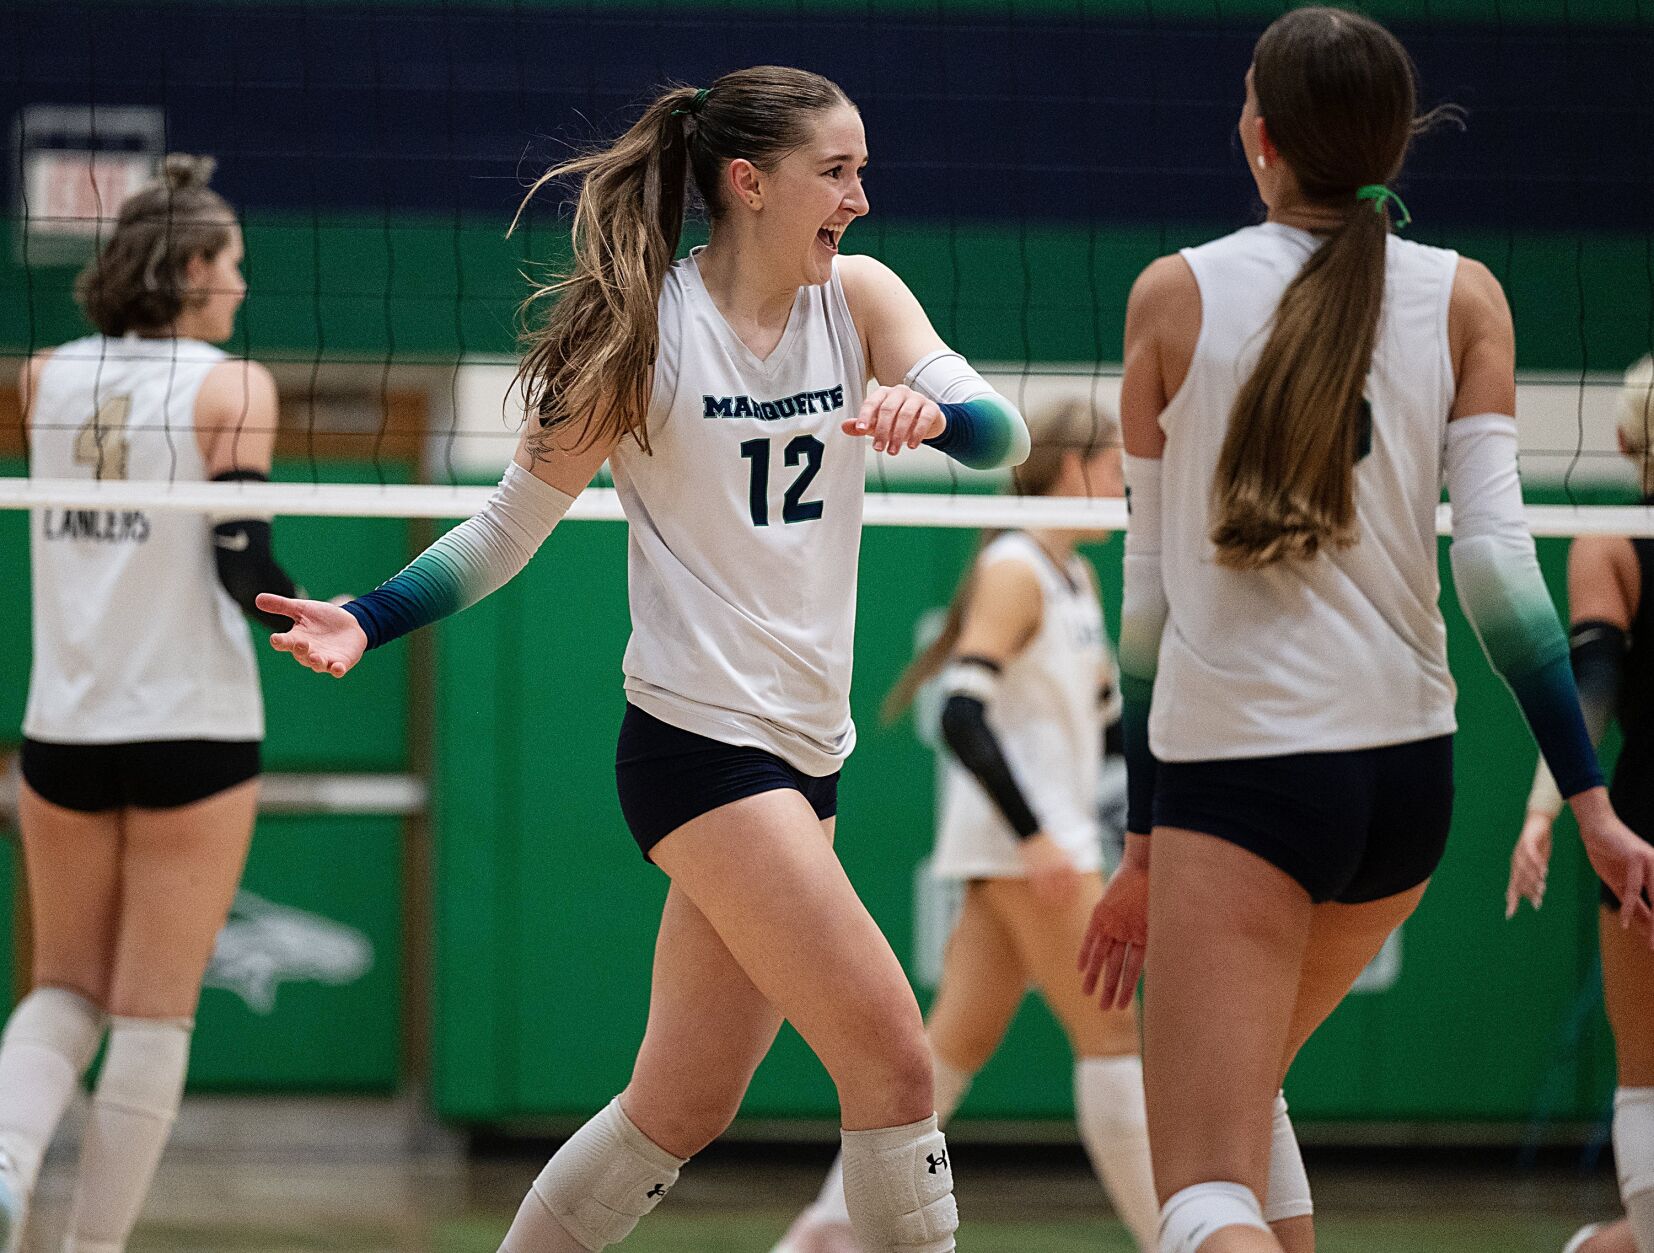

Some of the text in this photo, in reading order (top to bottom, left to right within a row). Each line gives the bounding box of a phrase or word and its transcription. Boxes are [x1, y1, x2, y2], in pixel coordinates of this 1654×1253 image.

[74, 392, 131, 481] 4
[702, 383, 844, 422] MARQUETTE
[740, 434, 825, 527] 12
